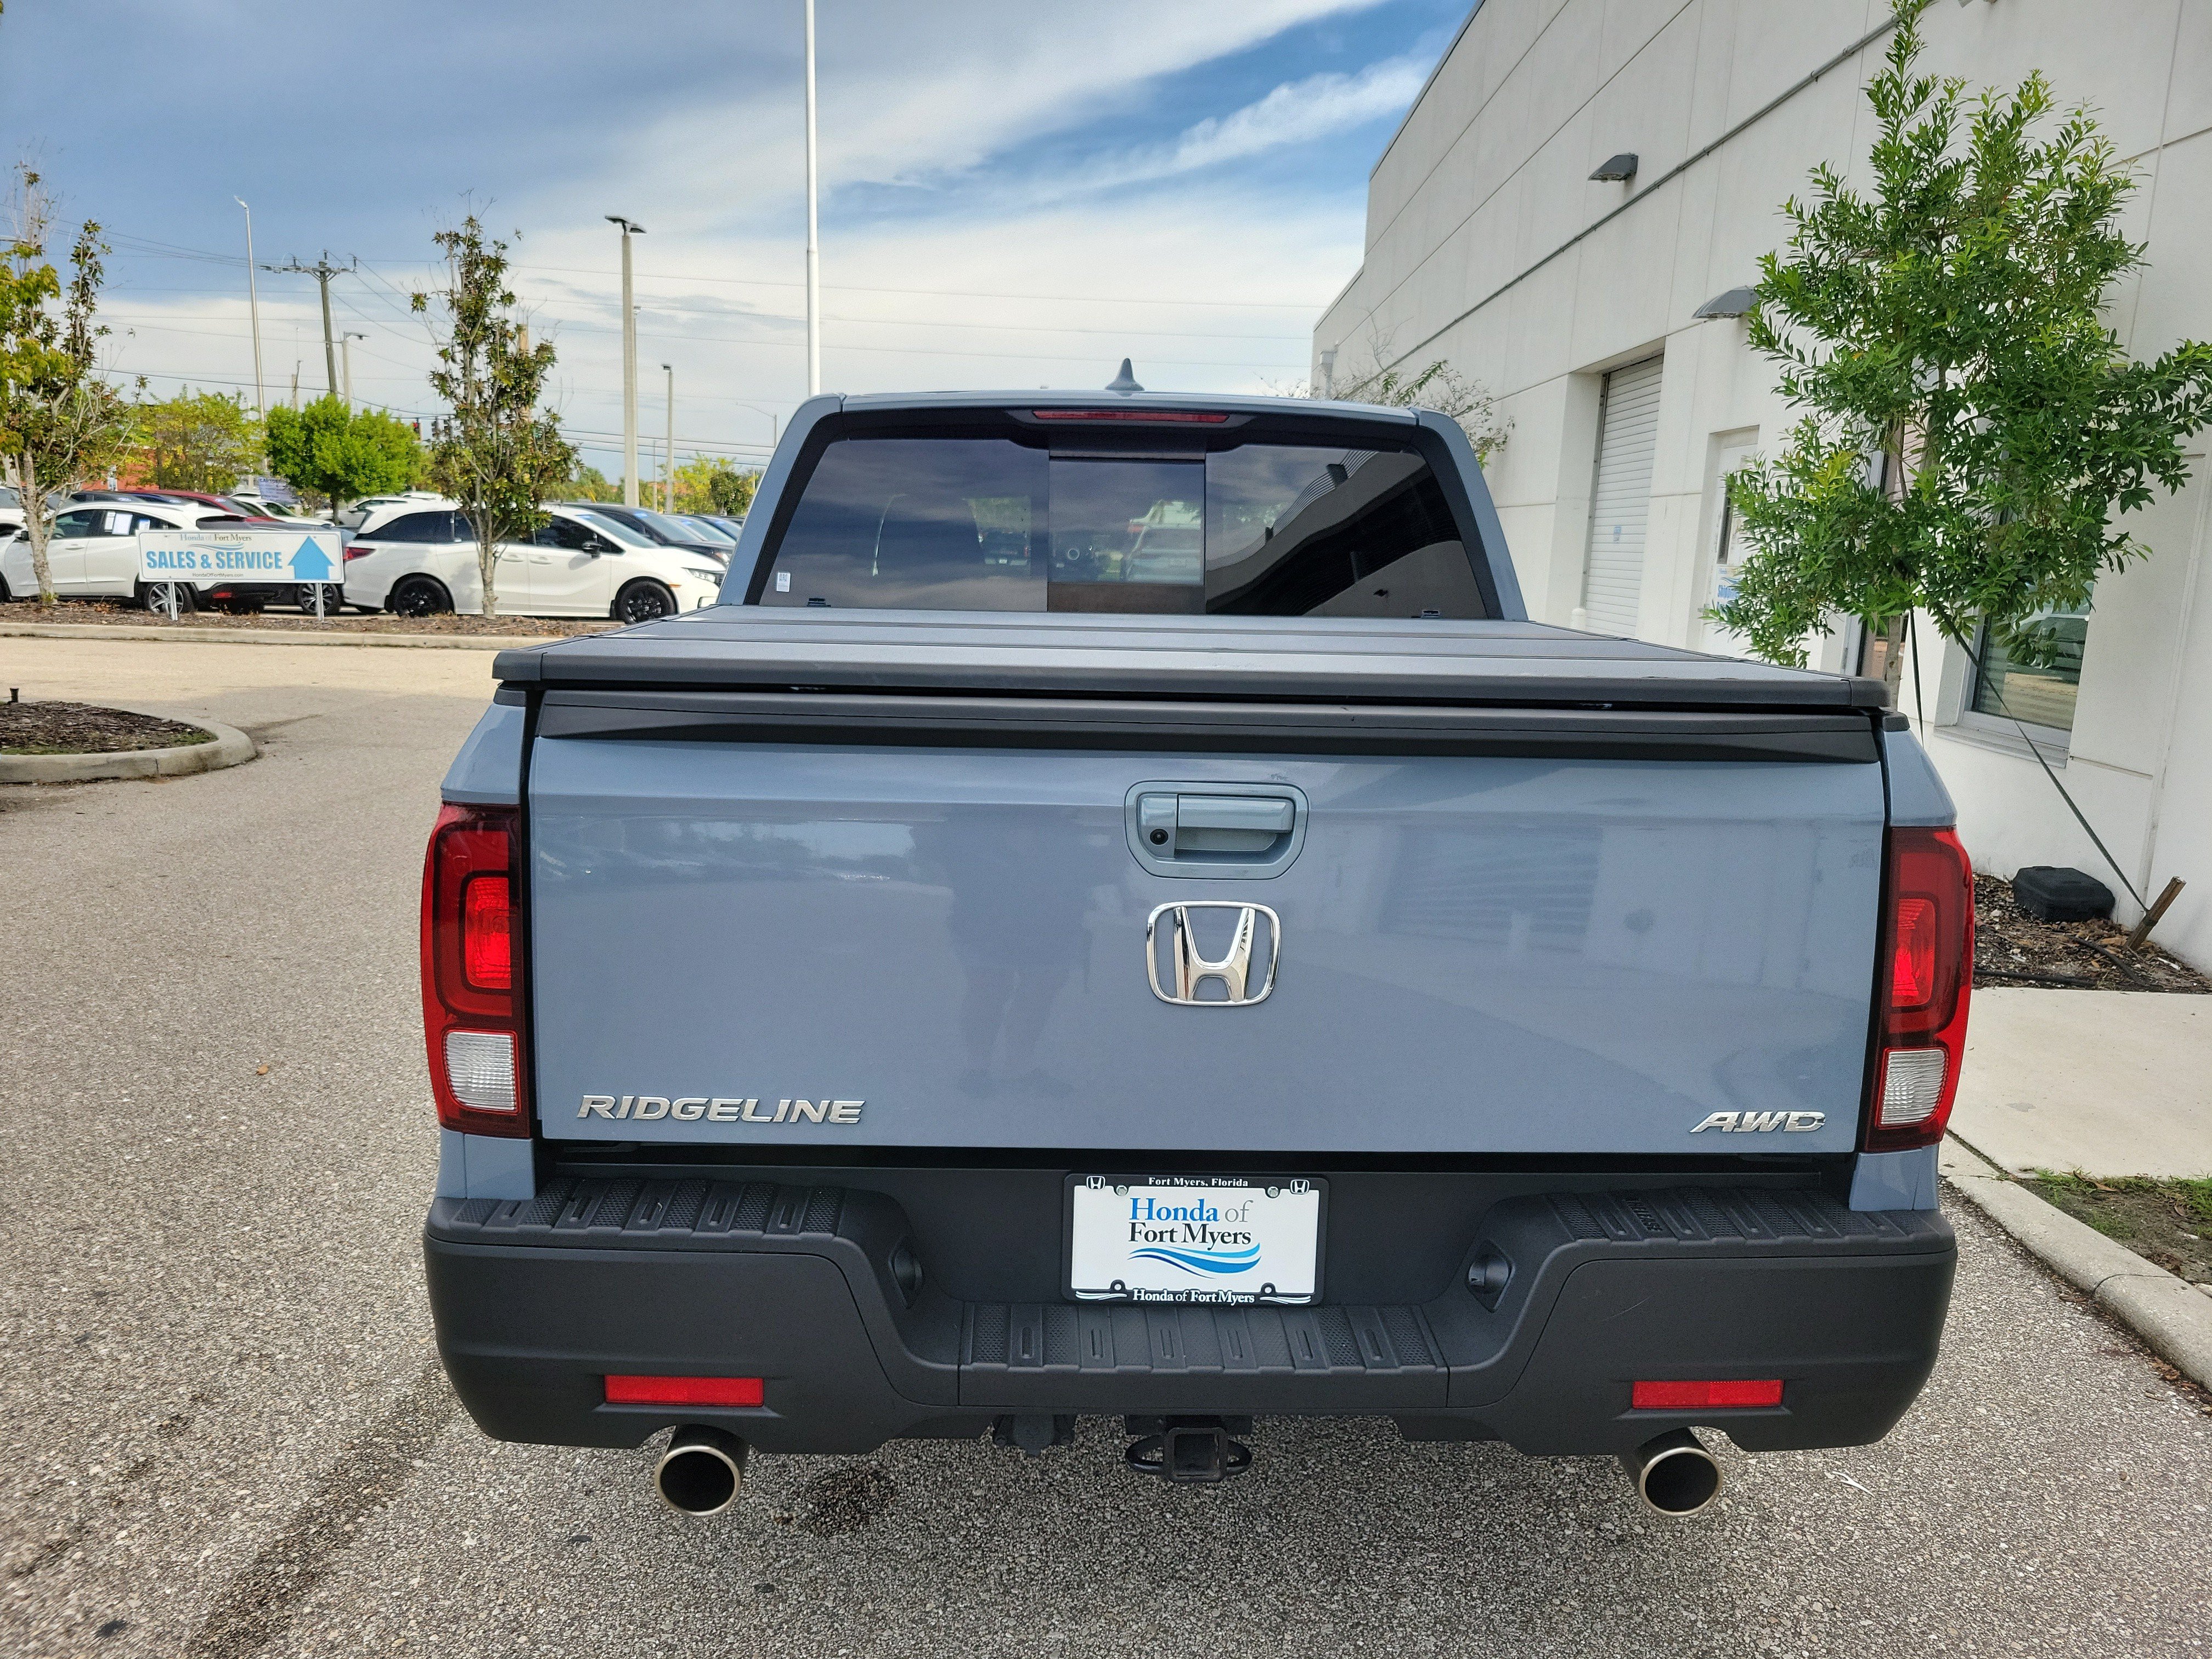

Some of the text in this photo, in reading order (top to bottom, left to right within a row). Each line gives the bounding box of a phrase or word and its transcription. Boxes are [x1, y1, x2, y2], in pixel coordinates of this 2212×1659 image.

[230, 534, 252, 543] Myers
[146, 551, 283, 569] SALES & SERVICE
[577, 1094, 865, 1124] RIDGELINE
[1689, 1111, 1826, 1132] AWD
[1149, 1177, 1248, 1187] Fort Myers, Florida
[1130, 1198, 1254, 1222] Honda of
[1128, 1222, 1251, 1250] Fort Myers
[1133, 1289, 1255, 1306] Honda of Fort Myers
